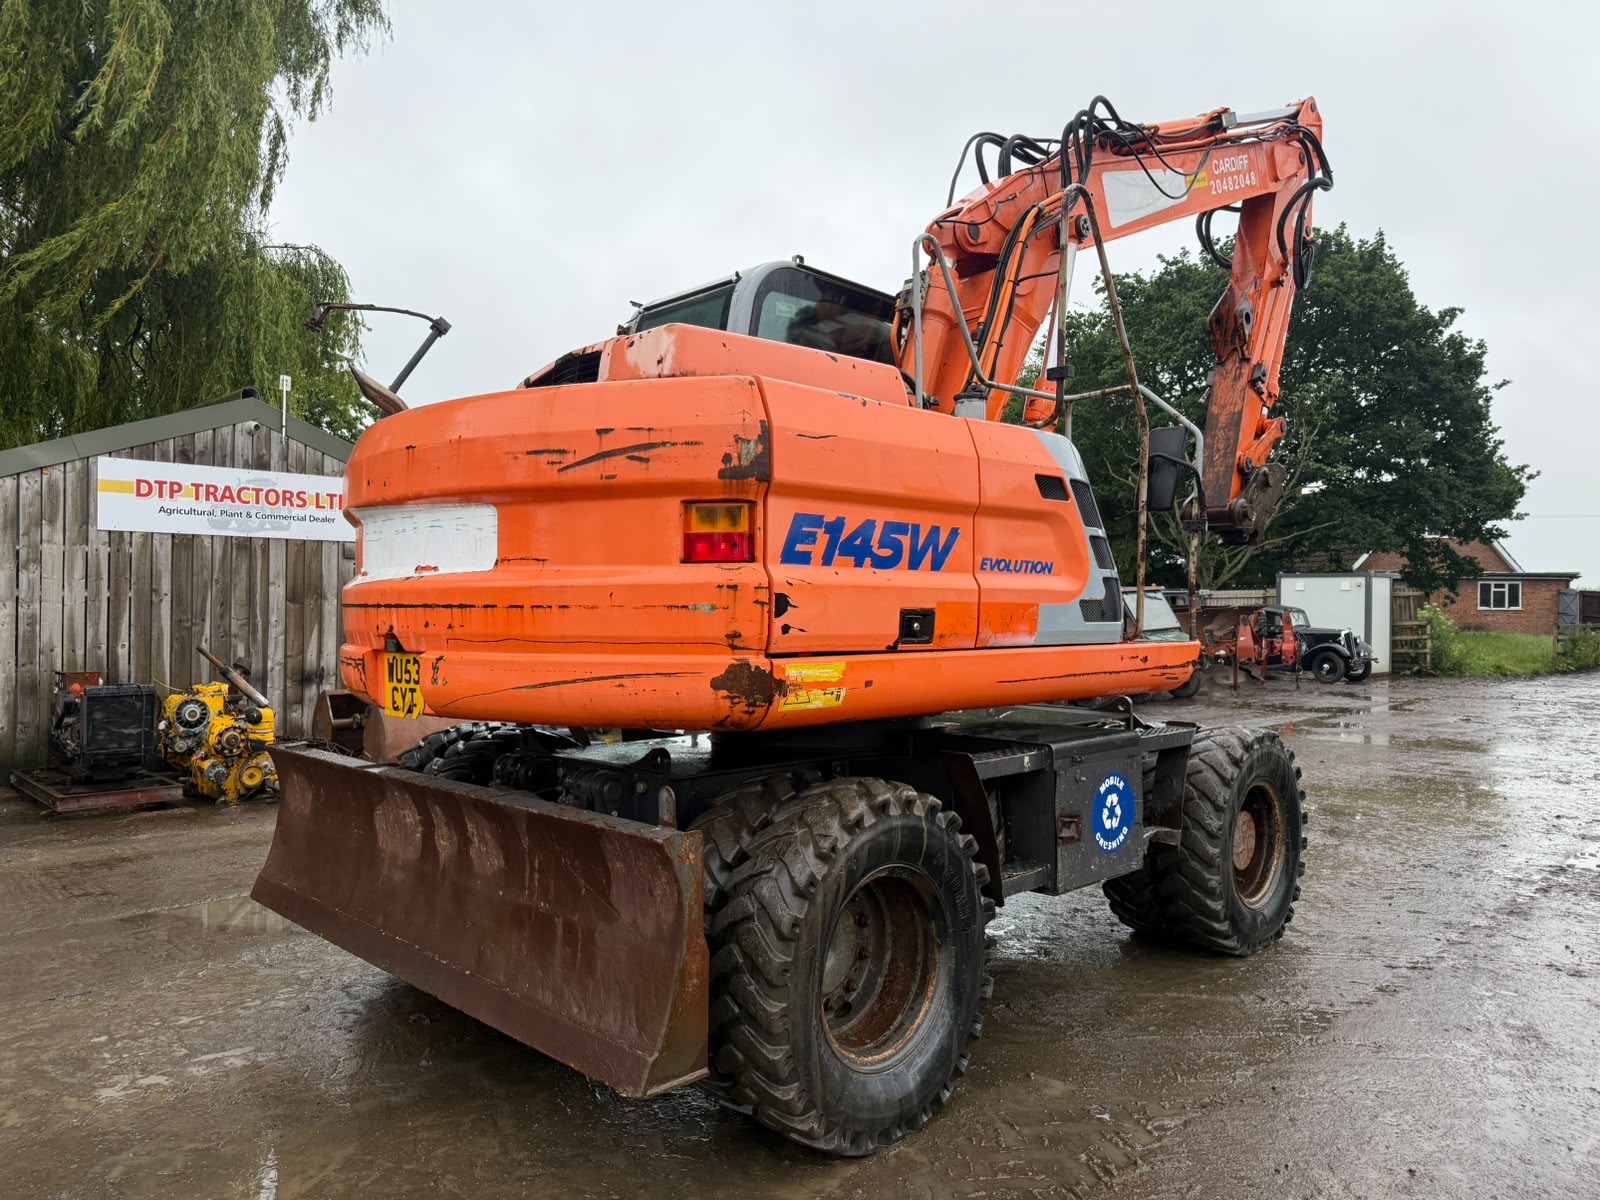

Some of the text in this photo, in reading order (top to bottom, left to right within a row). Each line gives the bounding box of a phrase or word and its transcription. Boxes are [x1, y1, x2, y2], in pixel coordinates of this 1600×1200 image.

[1212, 154, 1249, 175] CARDIFF
[1210, 171, 1257, 195] 20482048
[135, 478, 183, 499] DTP
[190, 483, 308, 509] TRACTORS
[158, 505, 336, 524] Agricultural, Plant & Commercial Dealer
[779, 512, 961, 572] E145W
[979, 557, 1054, 575] EVOLUTION
[387, 656, 420, 686] WU53
[1099, 775, 1125, 795] MOBILE
[1095, 826, 1129, 851] CRUSHING
